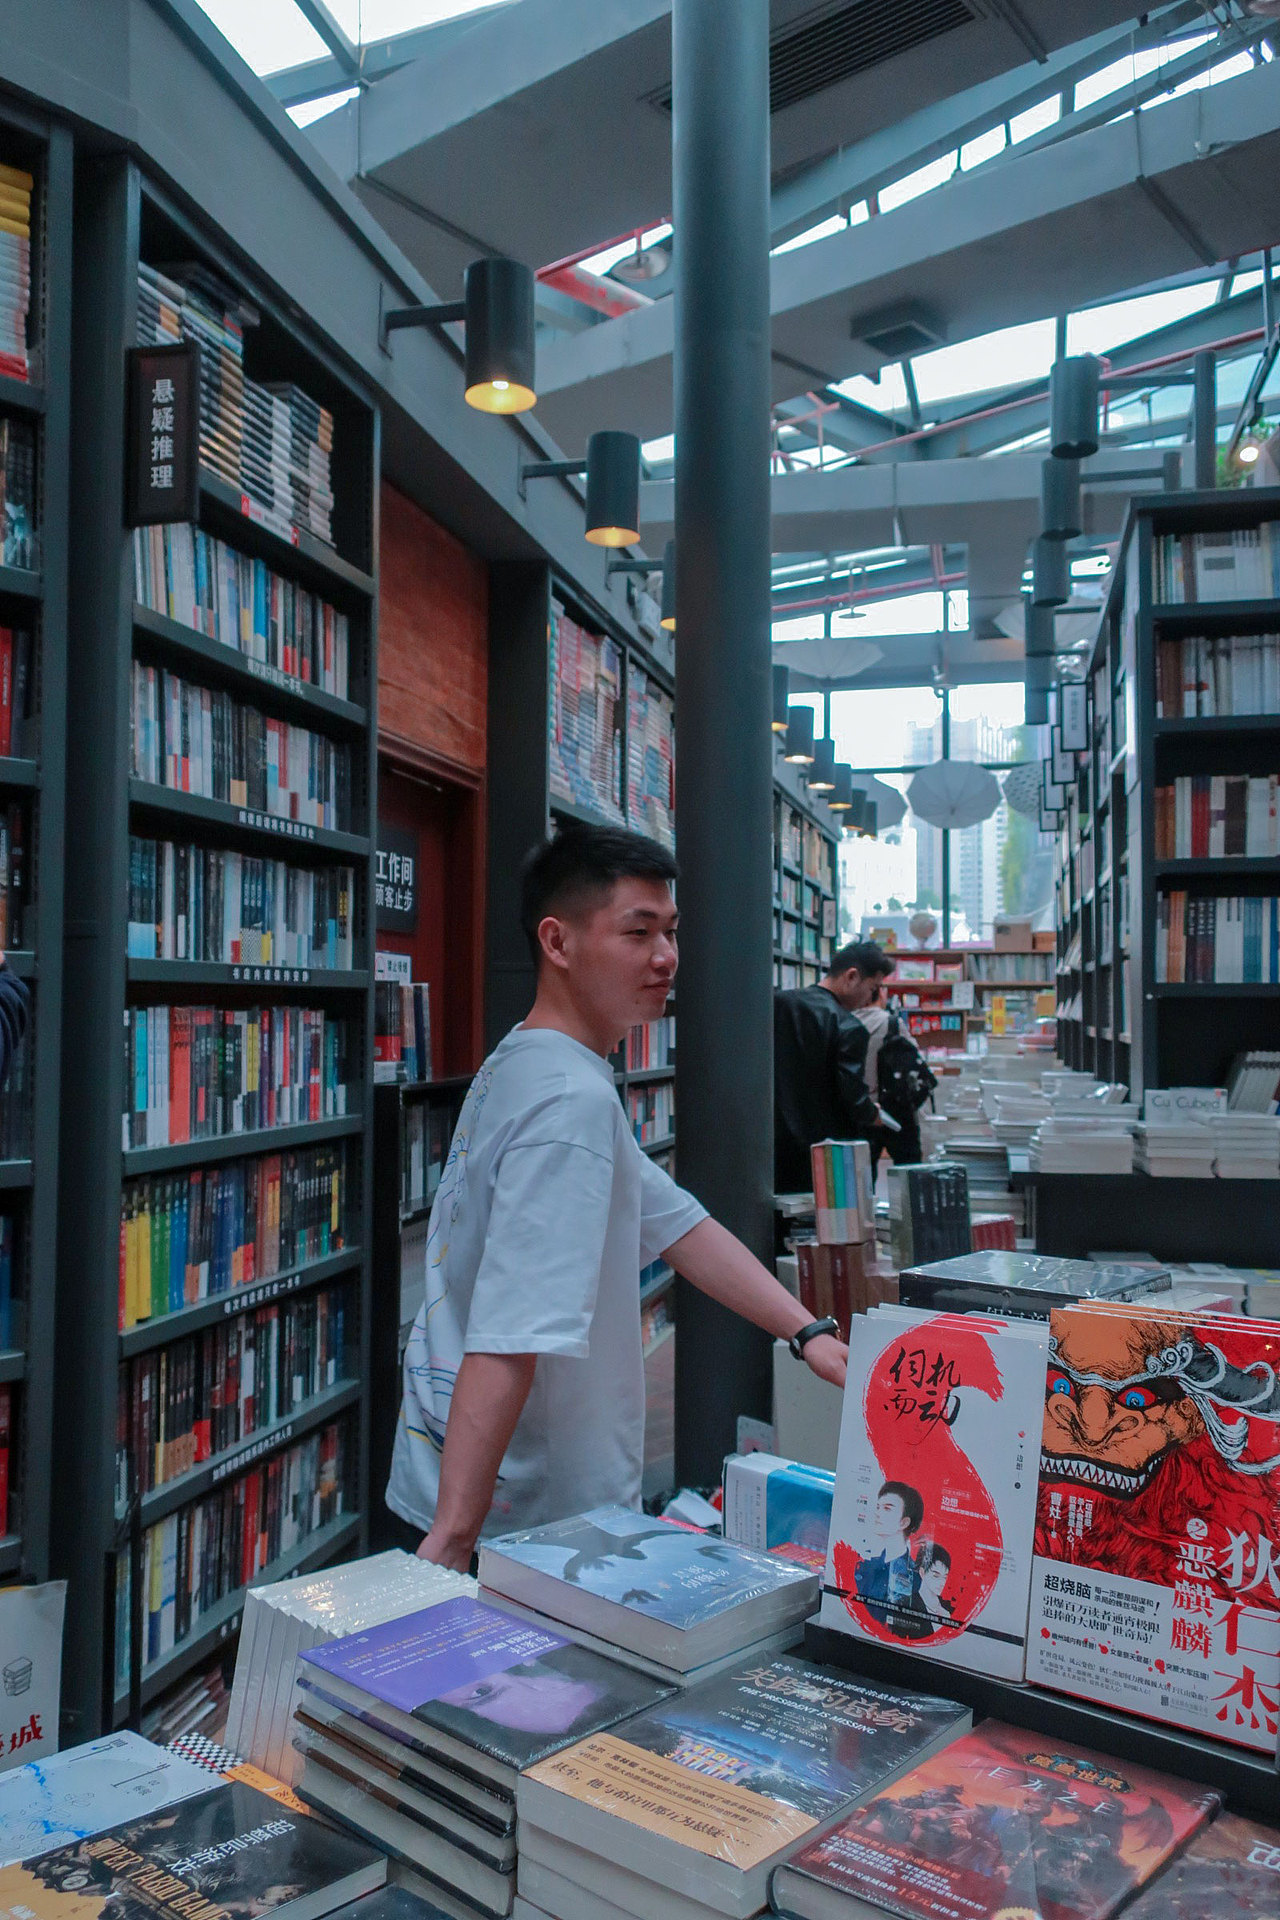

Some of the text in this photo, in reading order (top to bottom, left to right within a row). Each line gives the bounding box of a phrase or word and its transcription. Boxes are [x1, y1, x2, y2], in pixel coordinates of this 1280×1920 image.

[150, 378, 175, 489] 悬疑推理
[375, 851, 414, 886] 工作间
[375, 883, 413, 912] 顾客止步
[889, 1346, 961, 1389] 伺机
[883, 1388, 961, 1446] 而动
[1043, 1573, 1093, 1601] 超烧脑
[1169, 1517, 1217, 1660] 之恶麒麟
[1209, 1526, 1280, 1736] 狄仁杰
[730, 1667, 922, 1735] 失踪的总统
[738, 1685, 878, 1736] THE PRESIDENT IS MISSING
[1027, 1753, 1126, 1792] 魔兽世界
[165, 1818, 297, 1876] 超禁忌游戏
[126, 1863, 190, 1905] TABOO
